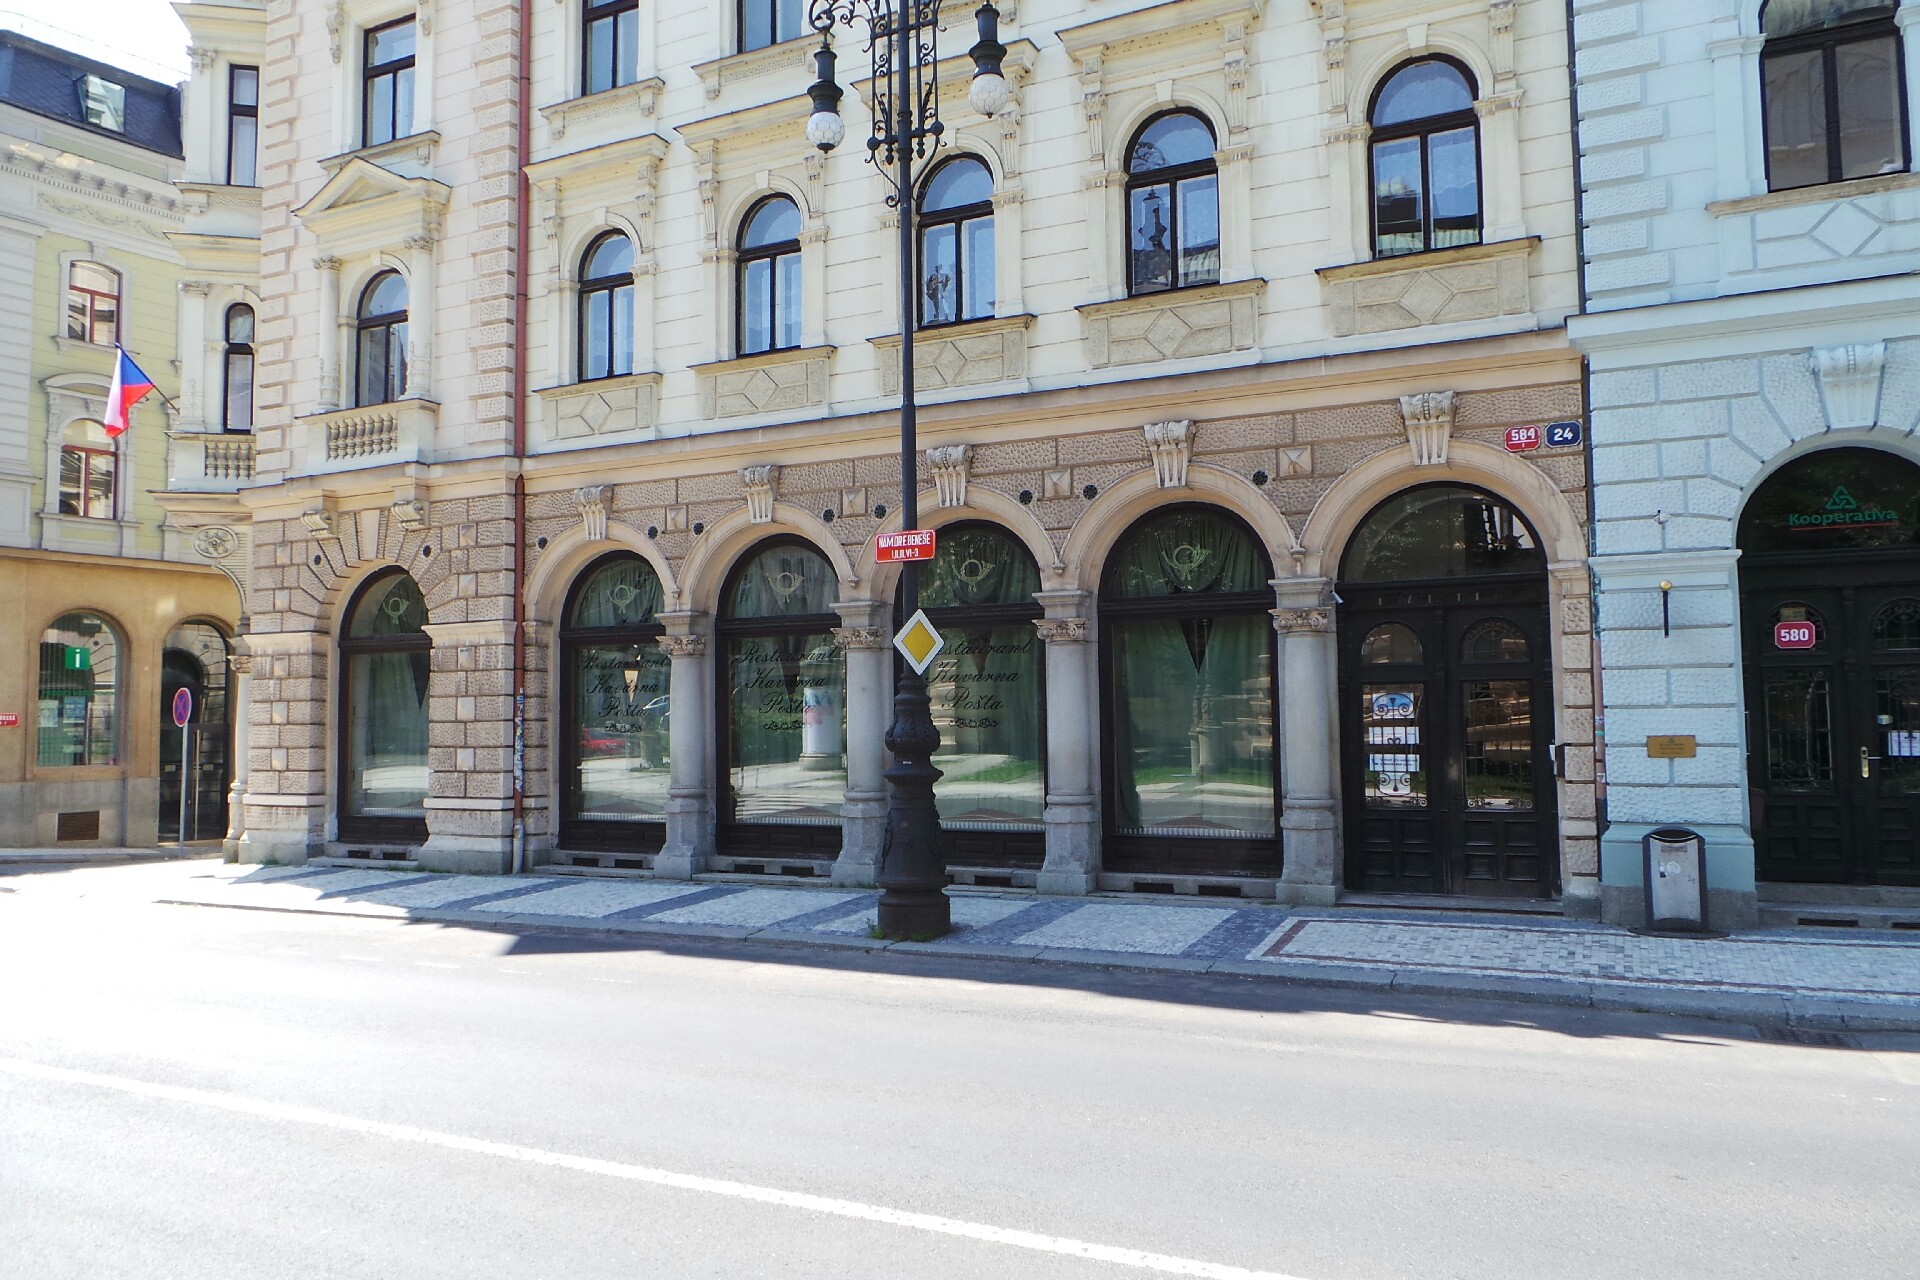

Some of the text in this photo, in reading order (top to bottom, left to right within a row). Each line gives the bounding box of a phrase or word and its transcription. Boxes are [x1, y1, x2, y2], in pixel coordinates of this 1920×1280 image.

[1511, 427, 1536, 441] 584
[1553, 427, 1574, 441] 24
[1788, 509, 1899, 526] Kooperativa
[1780, 628, 1809, 642] 580
[937, 638, 1034, 656] estaurant
[744, 666, 826, 689] Kavrna
[925, 659, 1019, 684] Kavárna
[586, 673, 659, 695] Kavárna
[598, 696, 646, 718] Pošta
[758, 691, 815, 714] Pošta
[941, 686, 1004, 711] Pošta
